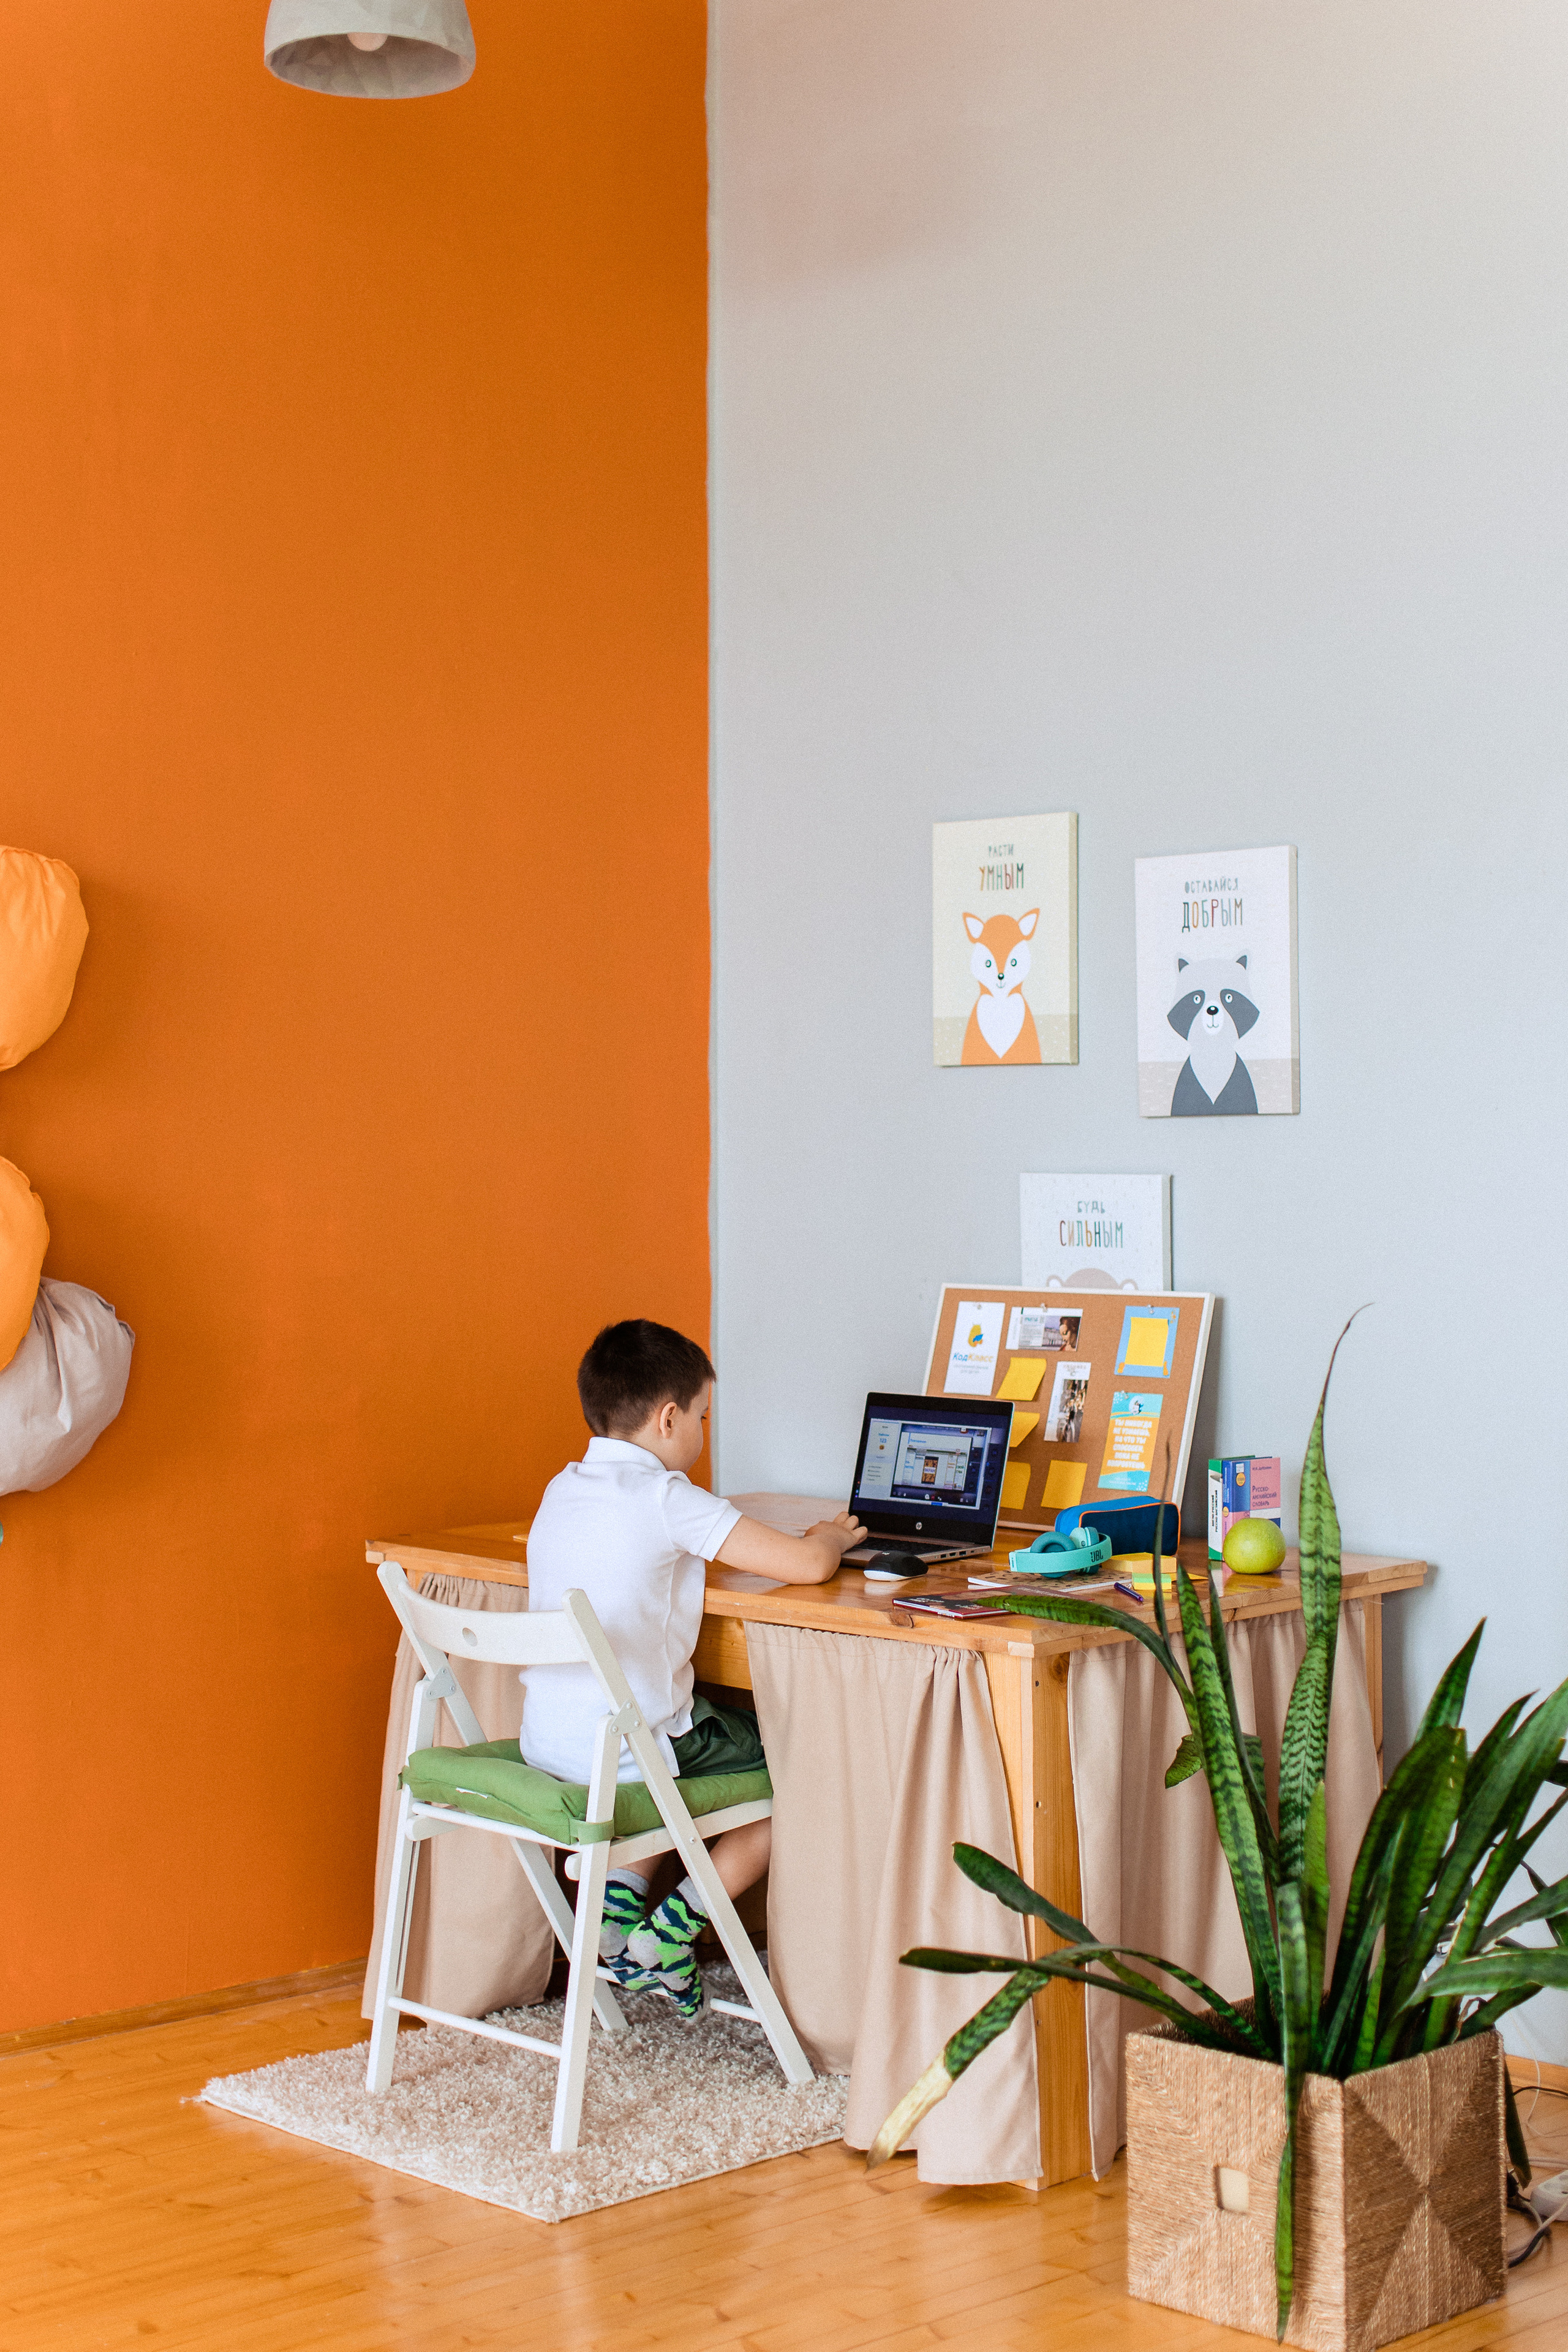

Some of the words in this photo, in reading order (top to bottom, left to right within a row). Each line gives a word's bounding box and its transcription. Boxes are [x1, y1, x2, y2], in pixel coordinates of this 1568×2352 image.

[988, 843, 1014, 857] РАСТИ
[979, 862, 1024, 892] УМНЫМ
[1184, 876, 1238, 894] ОСТАВАЙСЯ
[1182, 898, 1243, 933] ДОБРЫМ
[1077, 1200, 1106, 1214] БУДЬ
[1059, 1220, 1123, 1249] СИЛЬНЫМ
[1090, 1549, 1104, 1562] JBL
